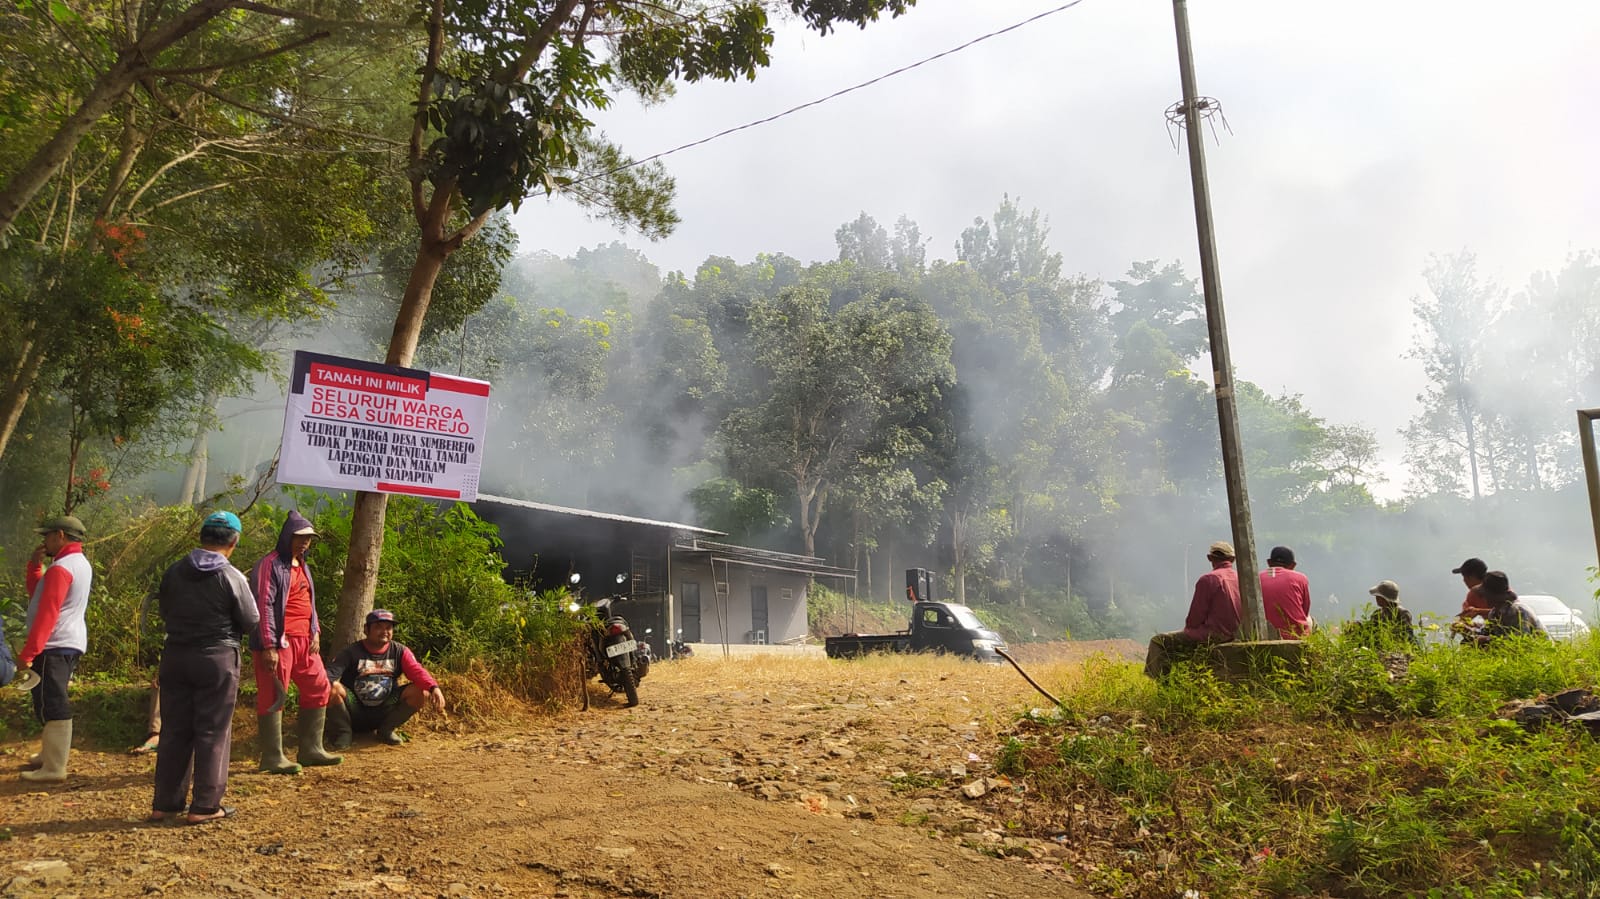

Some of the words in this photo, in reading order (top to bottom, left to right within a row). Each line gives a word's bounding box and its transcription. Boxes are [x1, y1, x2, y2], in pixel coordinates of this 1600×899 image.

[317, 369, 361, 386] TANAH
[366, 377, 382, 389] INI
[386, 380, 420, 394] MILIK
[311, 401, 360, 420] DESA
[365, 409, 470, 435] SUMBEREJO
[312, 387, 397, 411] SELURUH
[402, 400, 464, 420] WARGA
[300, 420, 347, 438] SELURUH
[351, 427, 389, 443] WARGA
[392, 432, 416, 447] DESA
[420, 437, 475, 454] SUMBEREJO
[307, 434, 342, 450] TIDAK
[344, 439, 387, 455] PERNAH
[391, 445, 432, 461] MENJUAL
[436, 450, 467, 465] TANAH
[328, 449, 383, 467] LAPANGAN
[386, 455, 407, 470] DAN
[410, 459, 446, 474] MAKAM
[339, 463, 381, 479] KEPADA
[385, 468, 434, 485] SIAPAPUN
